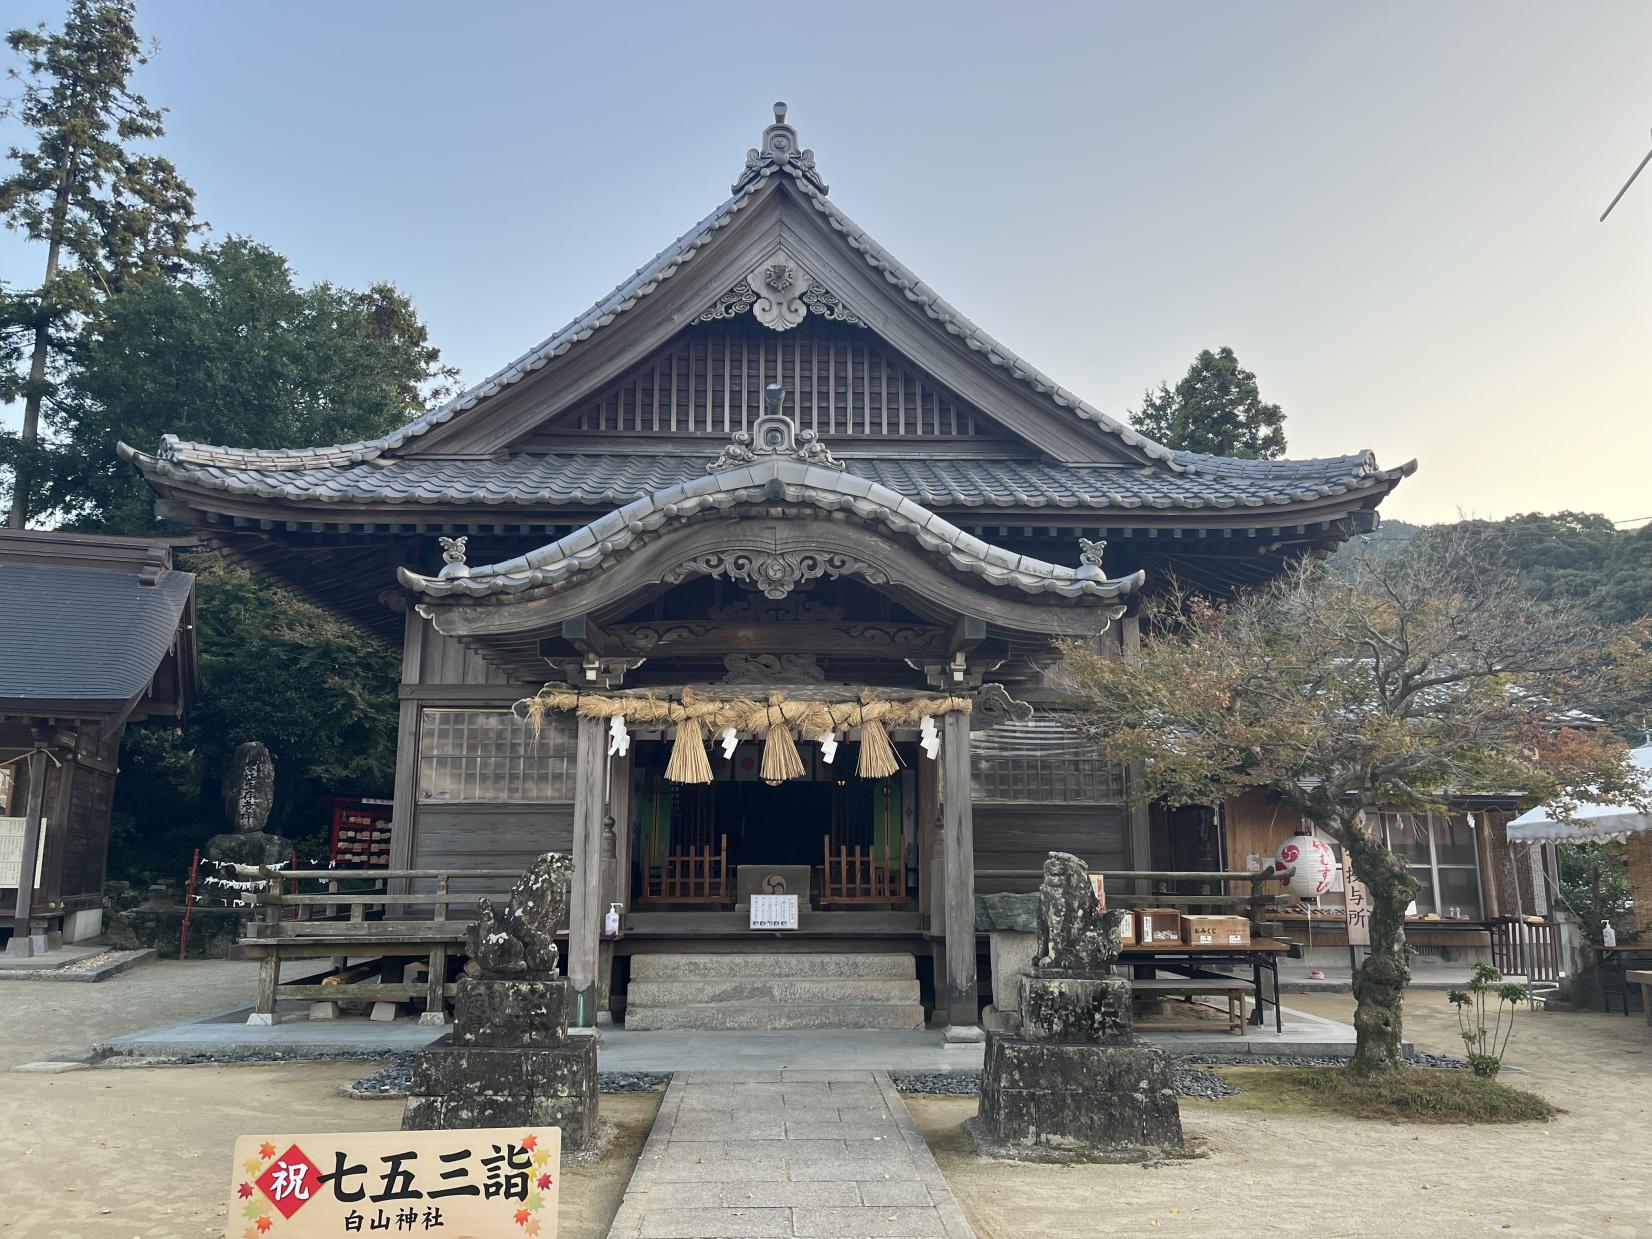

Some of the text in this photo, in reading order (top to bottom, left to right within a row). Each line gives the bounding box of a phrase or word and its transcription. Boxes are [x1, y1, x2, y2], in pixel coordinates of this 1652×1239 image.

[1194, 927, 1217, 935] おみくじ
[269, 1161, 310, 1201] 祝
[316, 1144, 533, 1203] 七五三詣
[344, 1206, 445, 1232] 白山神社
